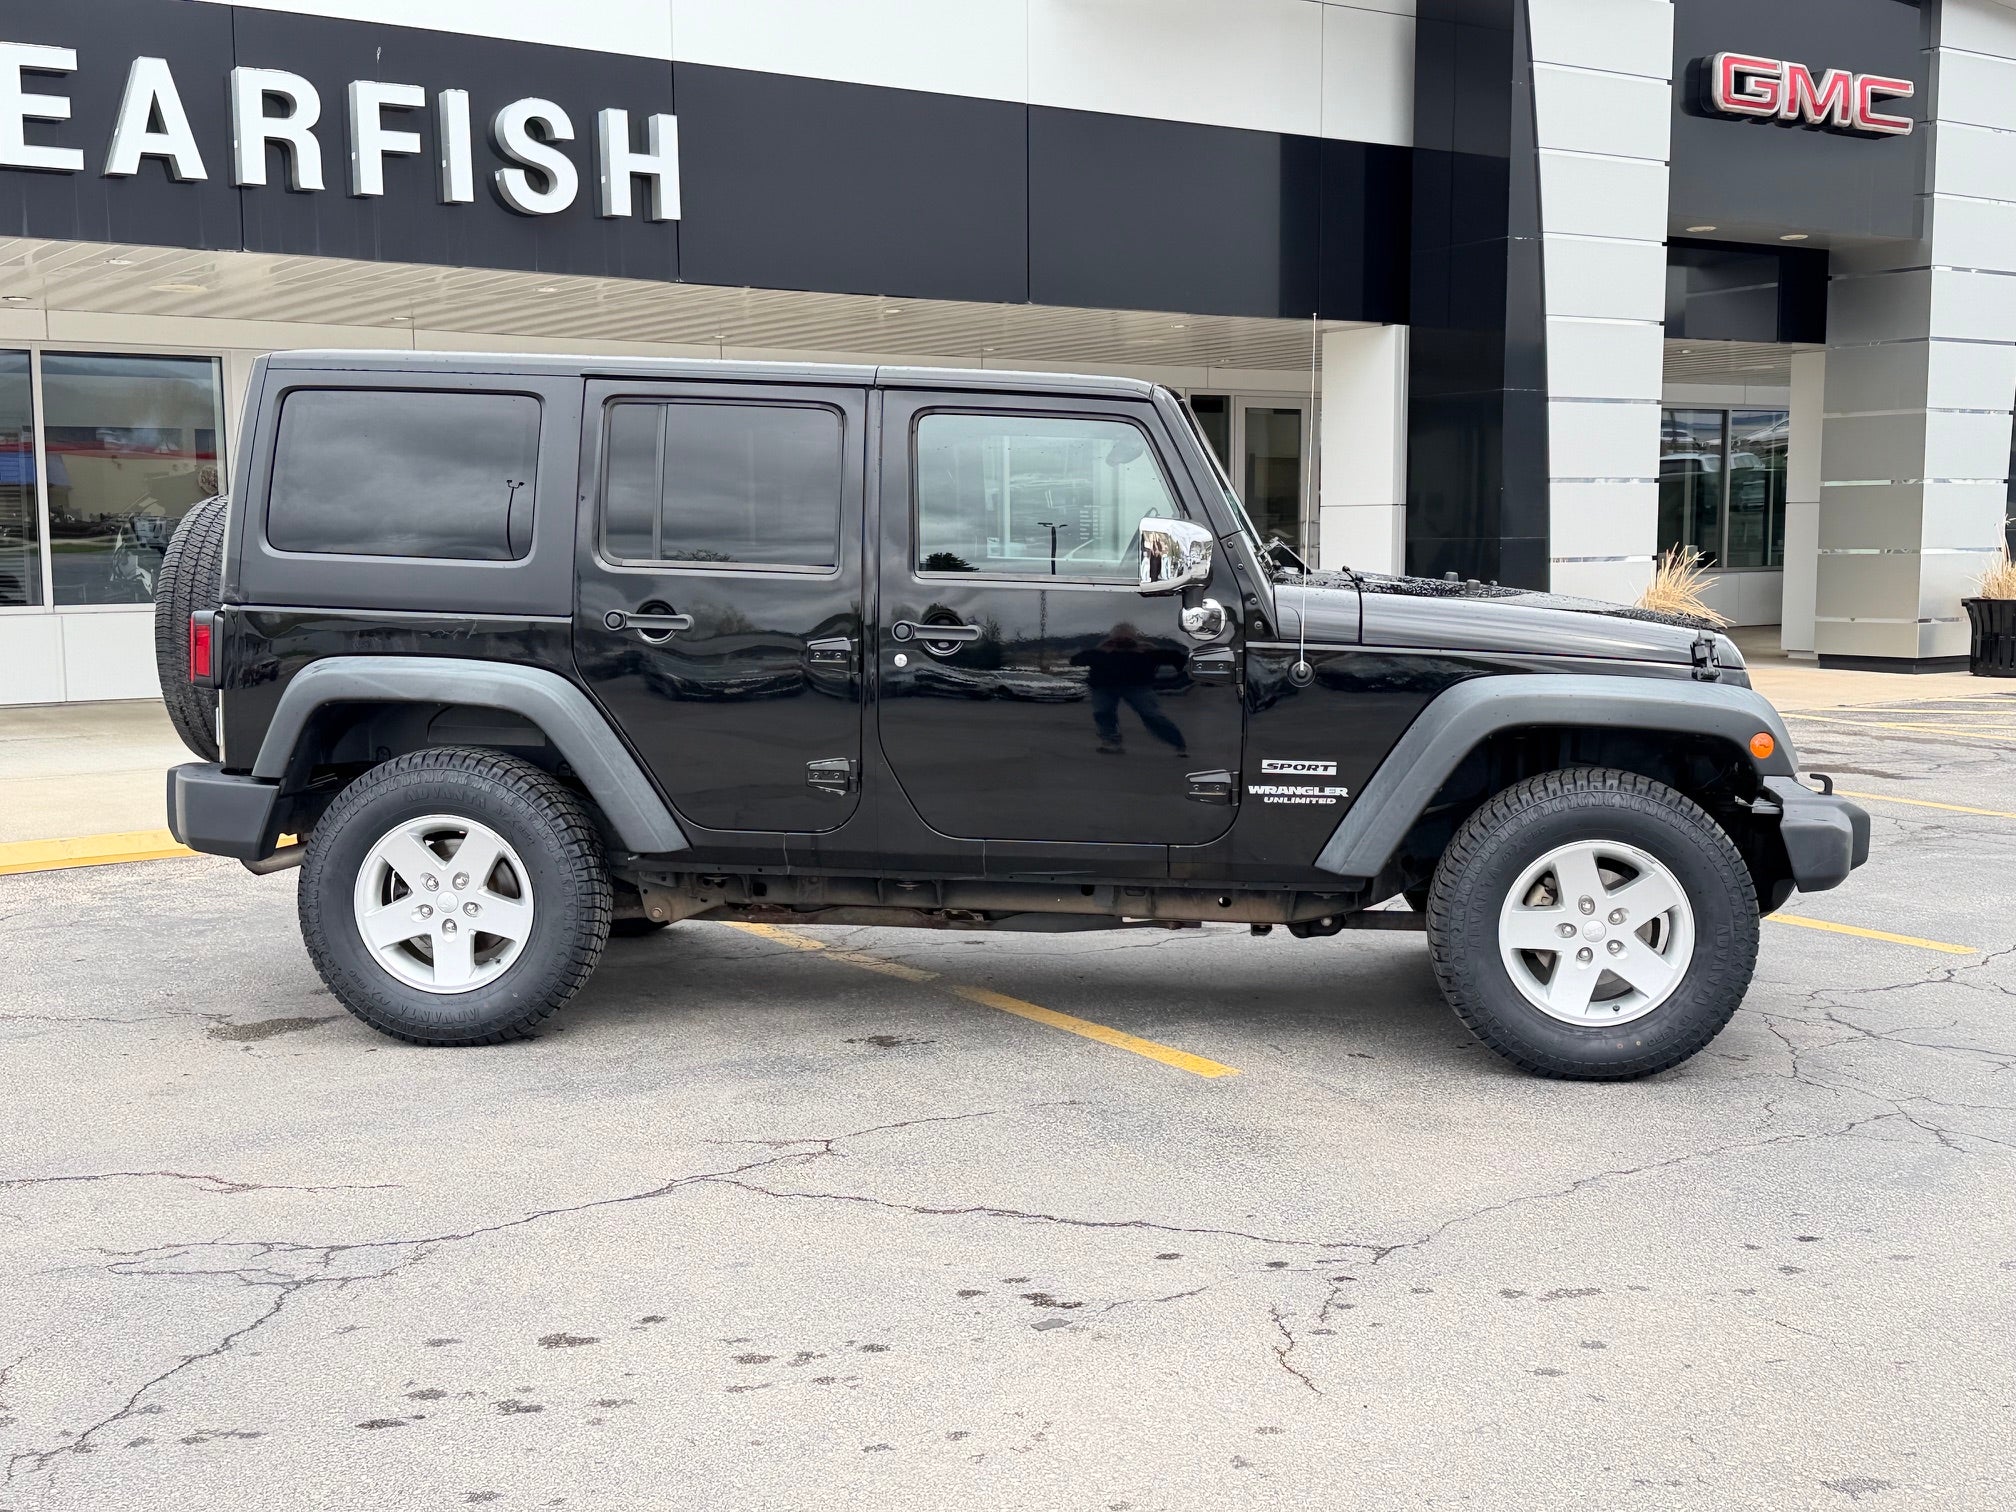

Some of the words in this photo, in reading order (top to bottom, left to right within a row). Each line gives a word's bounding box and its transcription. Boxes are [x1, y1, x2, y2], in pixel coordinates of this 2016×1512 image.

[1711, 51, 1915, 136] GMC
[0, 41, 682, 221] EARFISH
[1248, 785, 1349, 797] WRANGLER
[1263, 761, 1336, 773] SPORT
